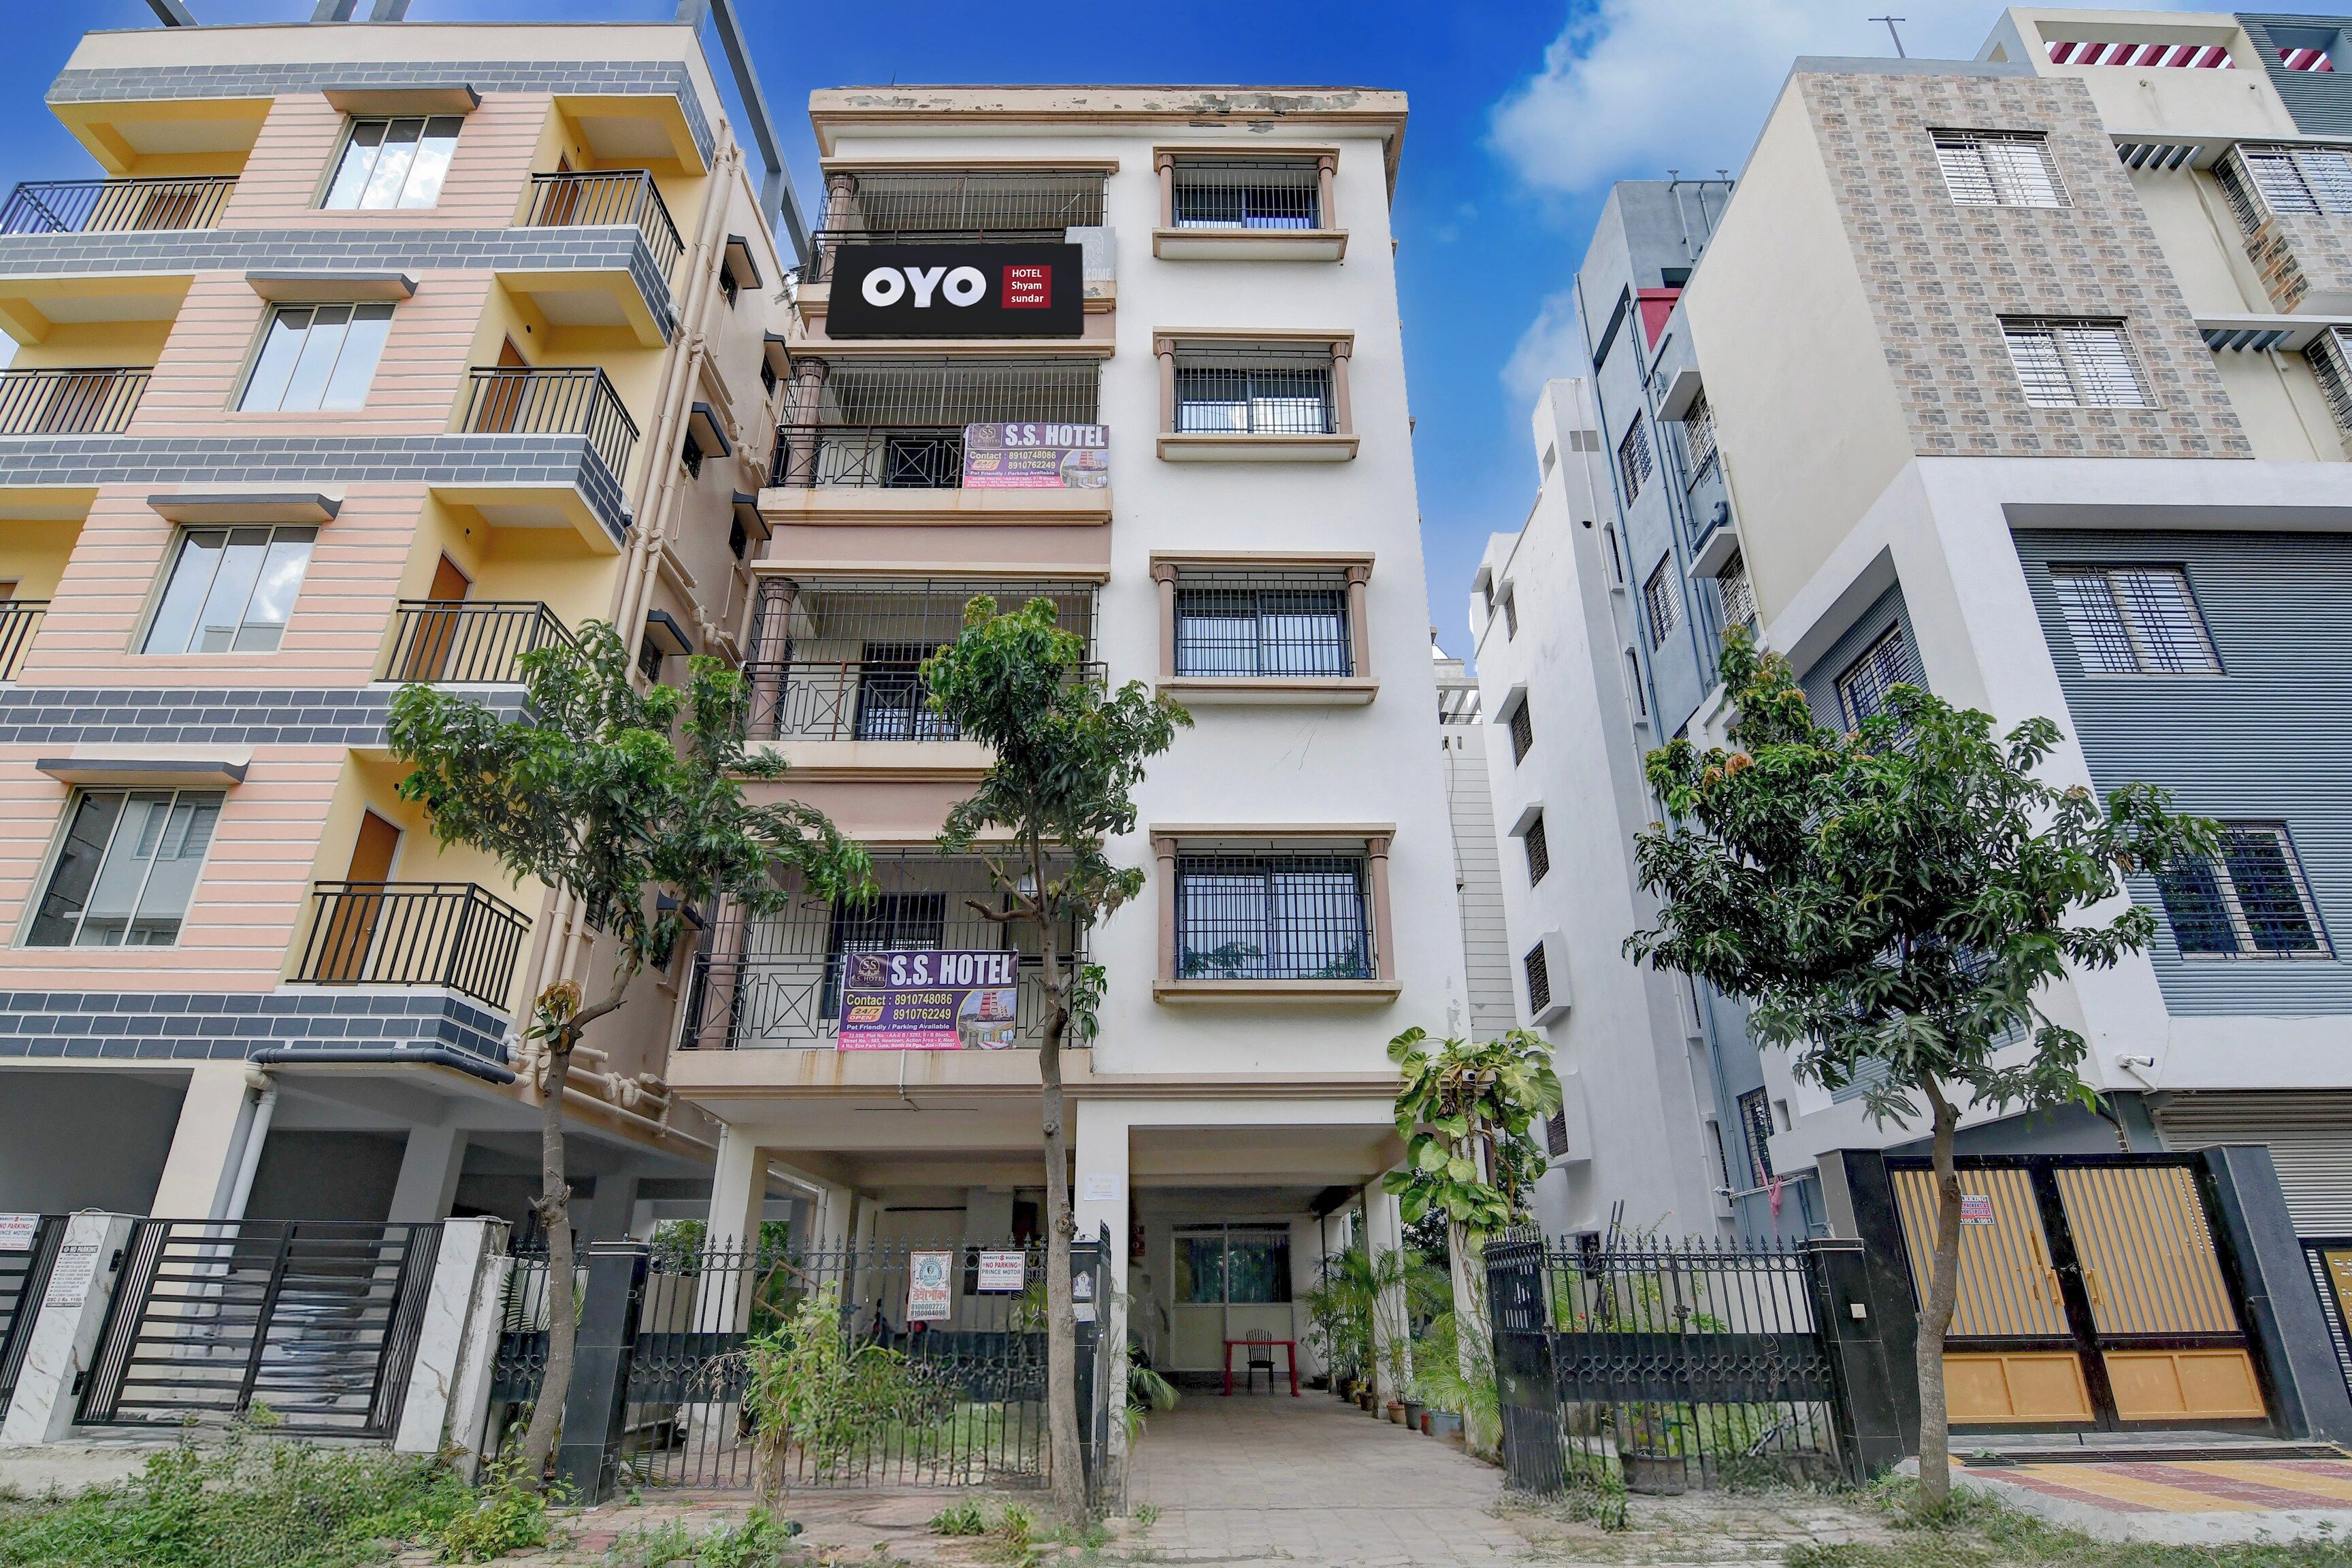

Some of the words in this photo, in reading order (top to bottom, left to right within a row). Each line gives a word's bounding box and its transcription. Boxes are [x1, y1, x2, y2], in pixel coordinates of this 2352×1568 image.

[1012, 269, 1042, 278] HOTEL
[1084, 268, 1111, 280] COME
[862, 266, 987, 308] OYO
[1011, 281, 1042, 291] Shyam
[1011, 294, 1044, 303] sundar
[1005, 424, 1040, 446] S.S.
[1045, 425, 1105, 446] HOTEL
[970, 451, 1002, 459] Contact
[1009, 451, 1056, 459] 8910748086
[1008, 461, 1056, 469] 8910762249
[891, 954, 933, 986] S.S.
[939, 954, 1012, 985] HOTEL
[847, 994, 886, 1006] Contact
[894, 994, 953, 1005] 8910748086
[893, 1008, 951, 1020] 8910762249
